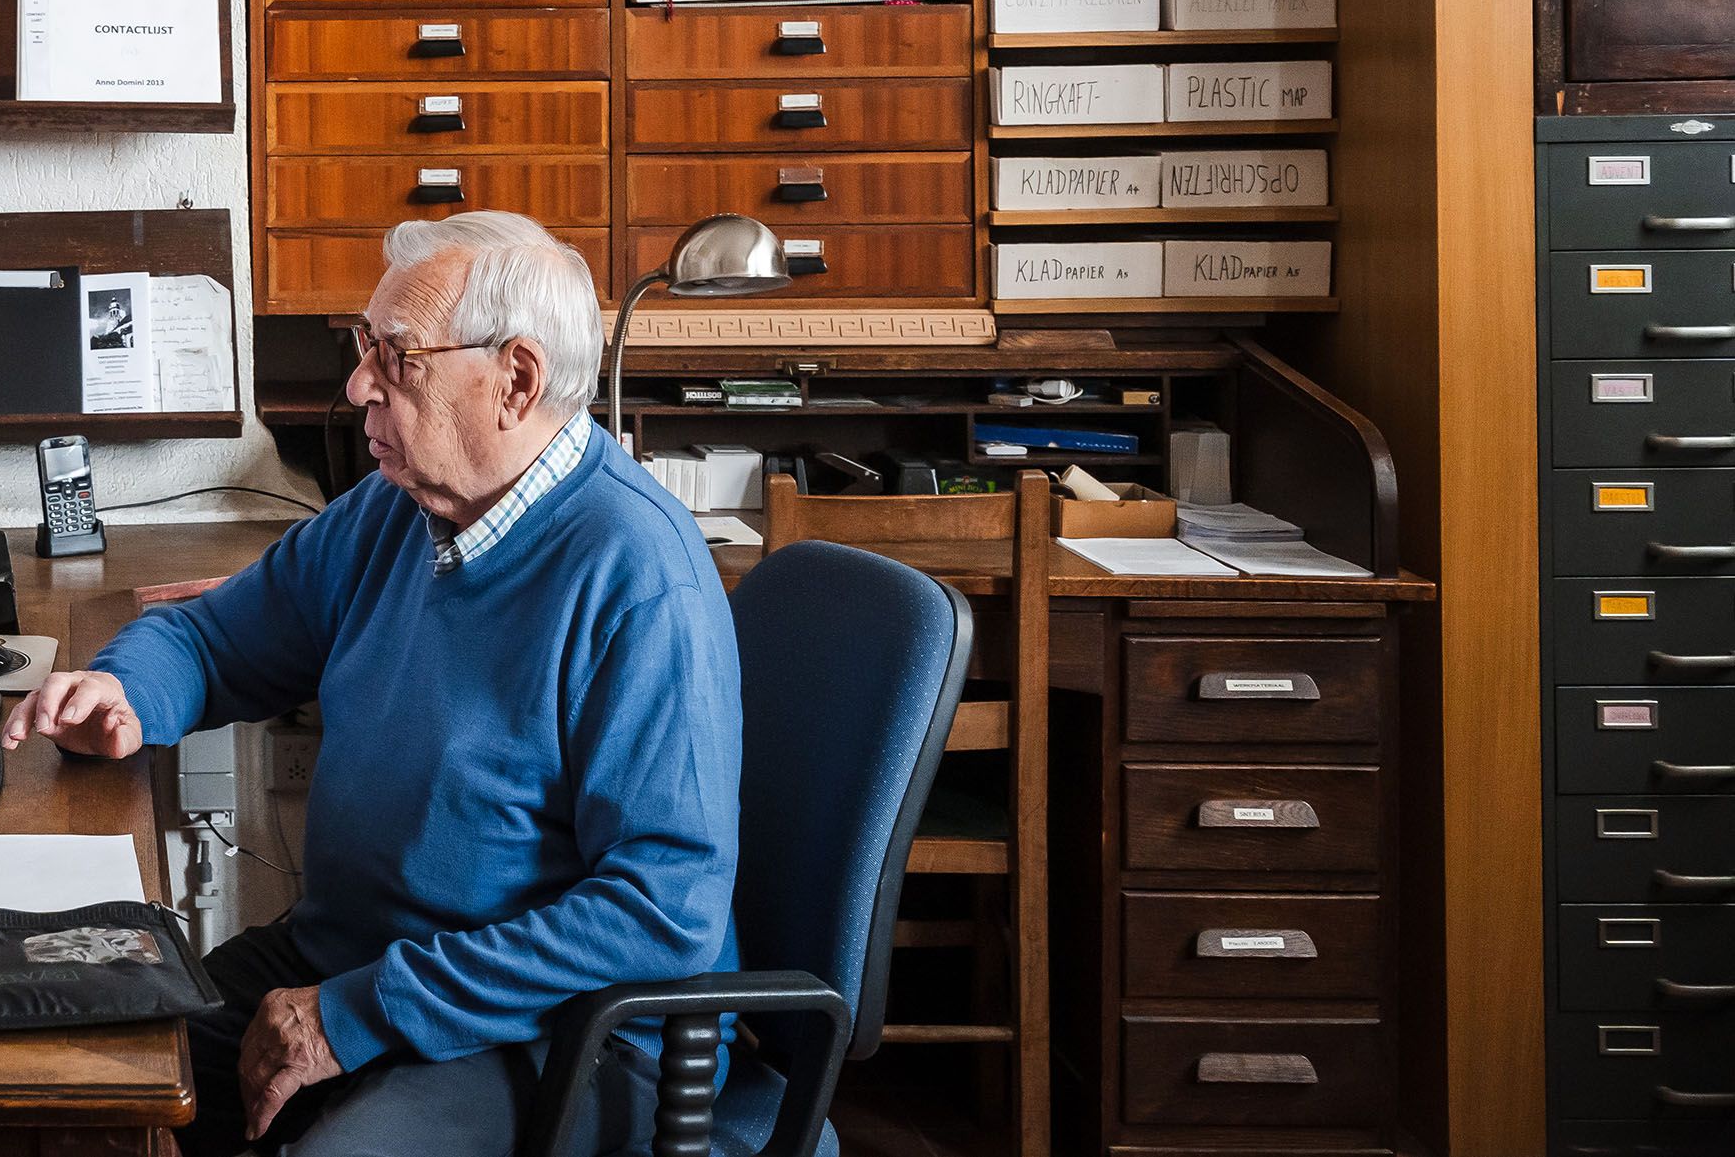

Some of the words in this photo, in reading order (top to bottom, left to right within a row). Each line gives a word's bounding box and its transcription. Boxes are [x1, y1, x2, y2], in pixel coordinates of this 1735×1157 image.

[94, 25, 174, 35] CONTACTLIJST
[1188, 74, 1270, 108] PLASTIC
[1281, 87, 1308, 108] MAP
[1171, 163, 1299, 196] OPSCHRIFTEN
